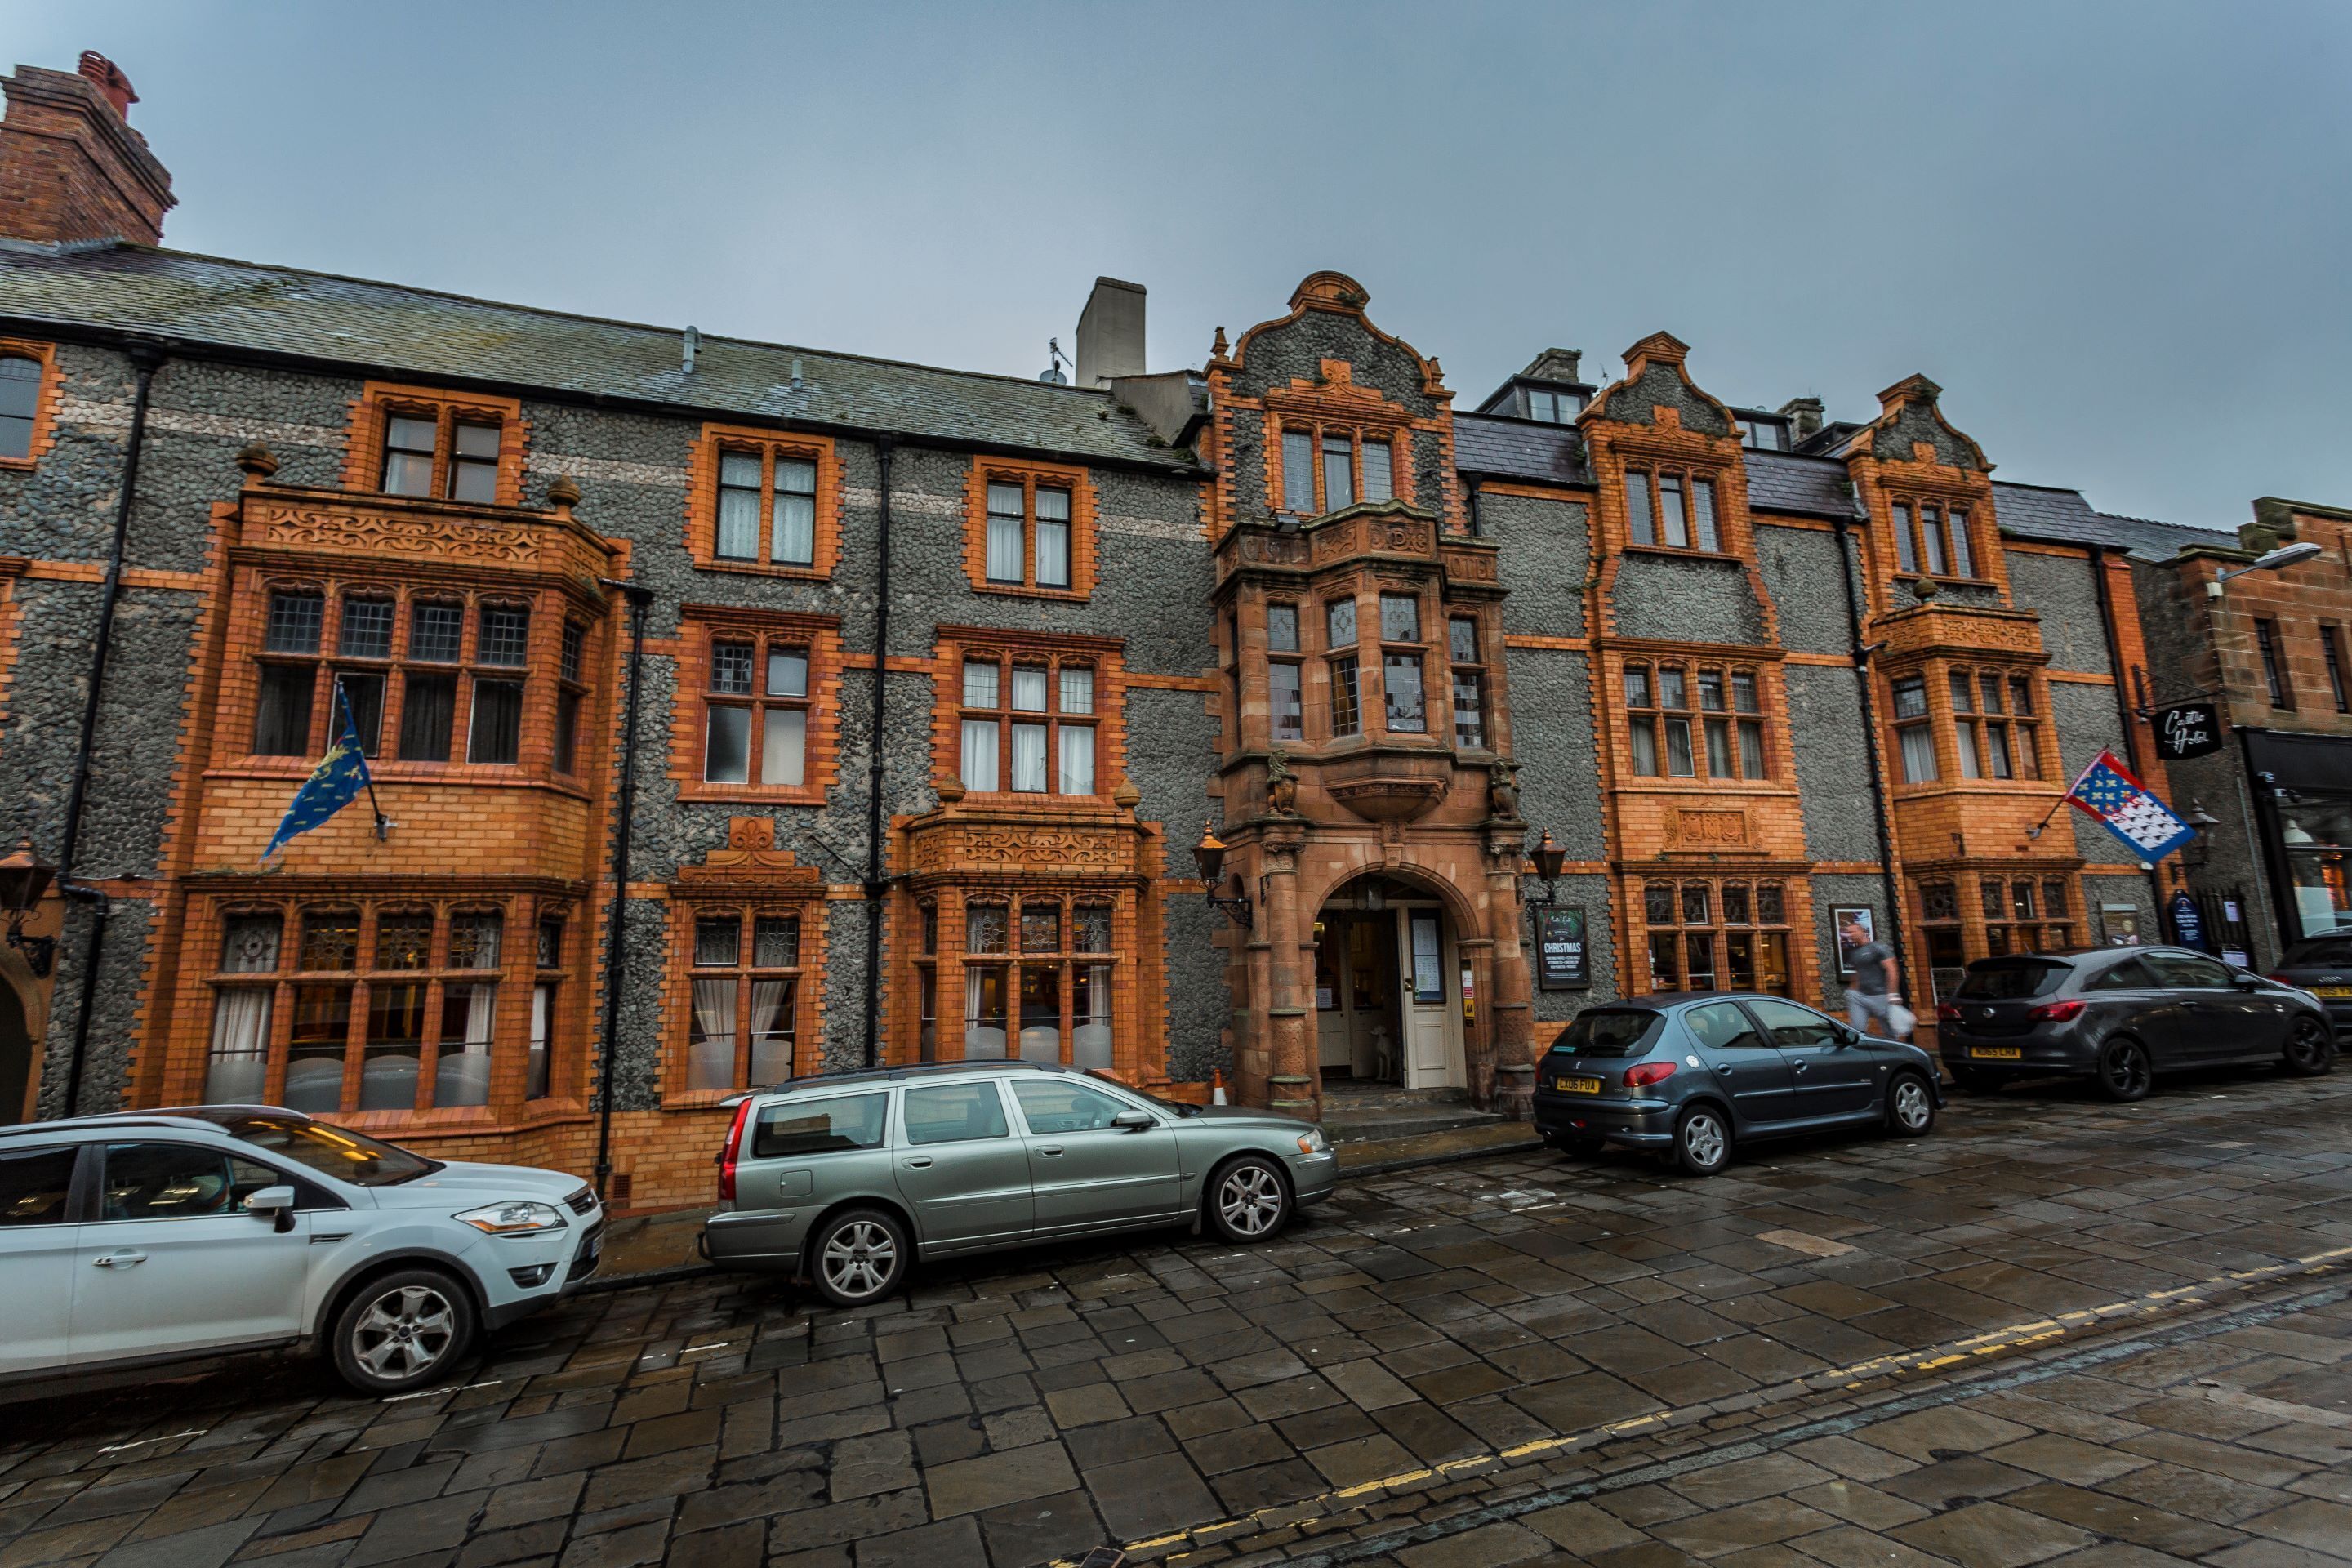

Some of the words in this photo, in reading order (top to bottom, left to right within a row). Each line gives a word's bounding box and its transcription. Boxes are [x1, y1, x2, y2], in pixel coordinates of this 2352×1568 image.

[2164, 710, 2206, 735] Castle
[2163, 728, 2210, 754] Hotel
[1544, 942, 1582, 954] CHRISTMAS
[1579, 1080, 1597, 1091] FUA
